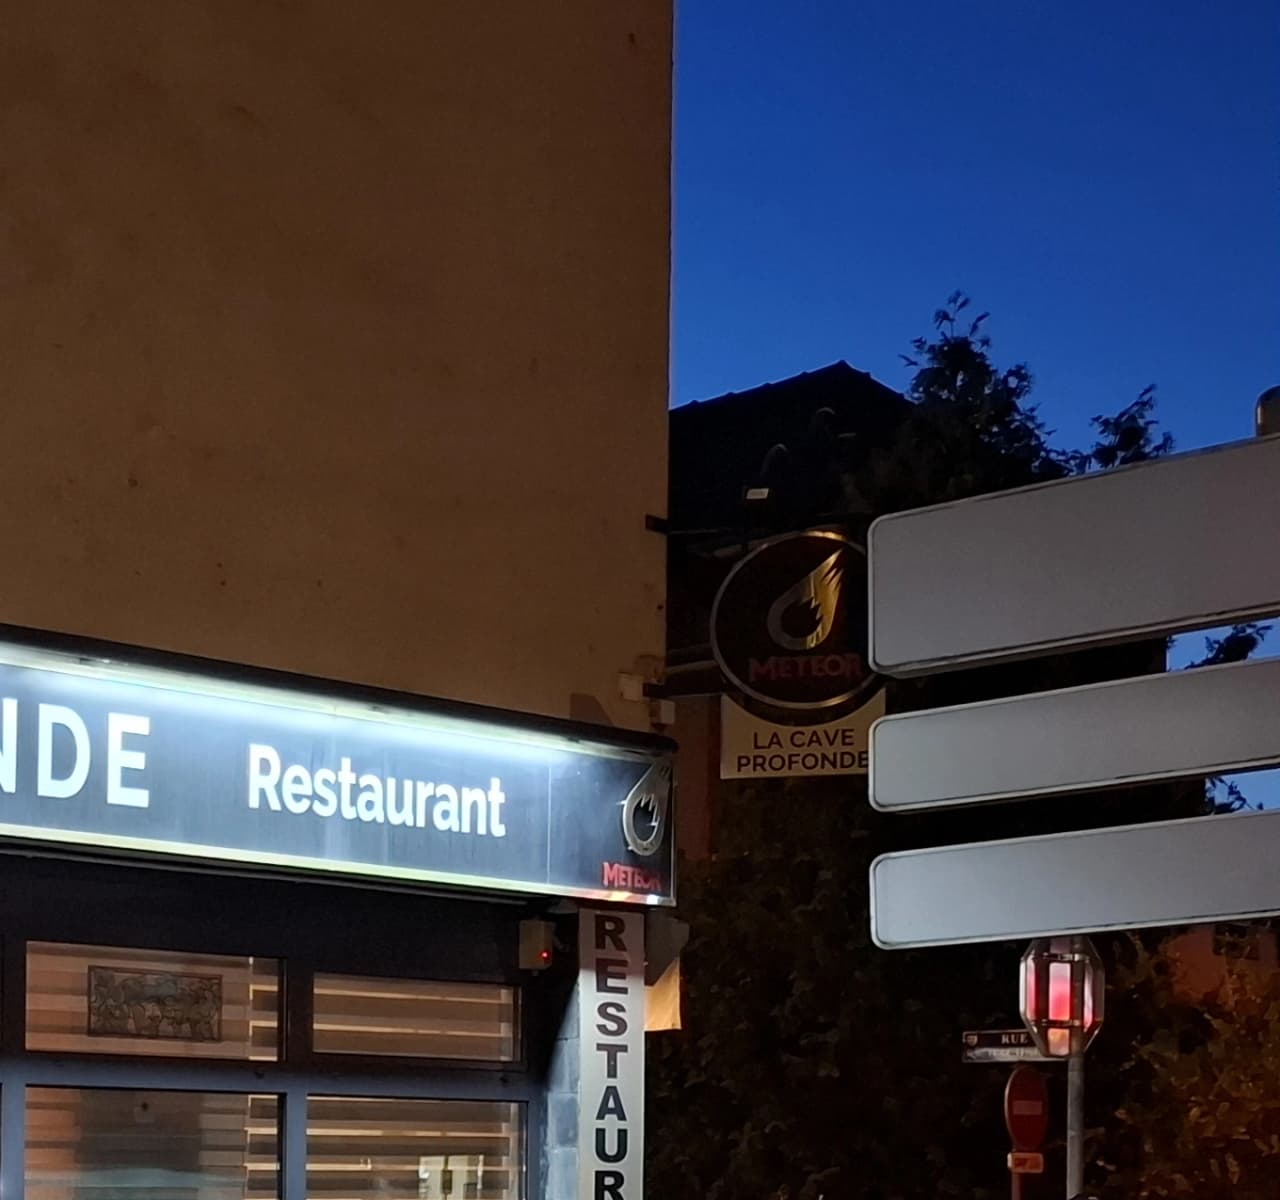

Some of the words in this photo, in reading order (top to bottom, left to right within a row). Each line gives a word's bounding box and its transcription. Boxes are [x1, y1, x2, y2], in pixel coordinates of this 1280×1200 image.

[749, 654, 863, 681] METEOR
[753, 732, 783, 749] LA
[790, 729, 855, 748] CAVE
[737, 750, 869, 772] PROFONDE
[247, 744, 506, 838] Restaurant
[1001, 1034, 1028, 1044] RUE
